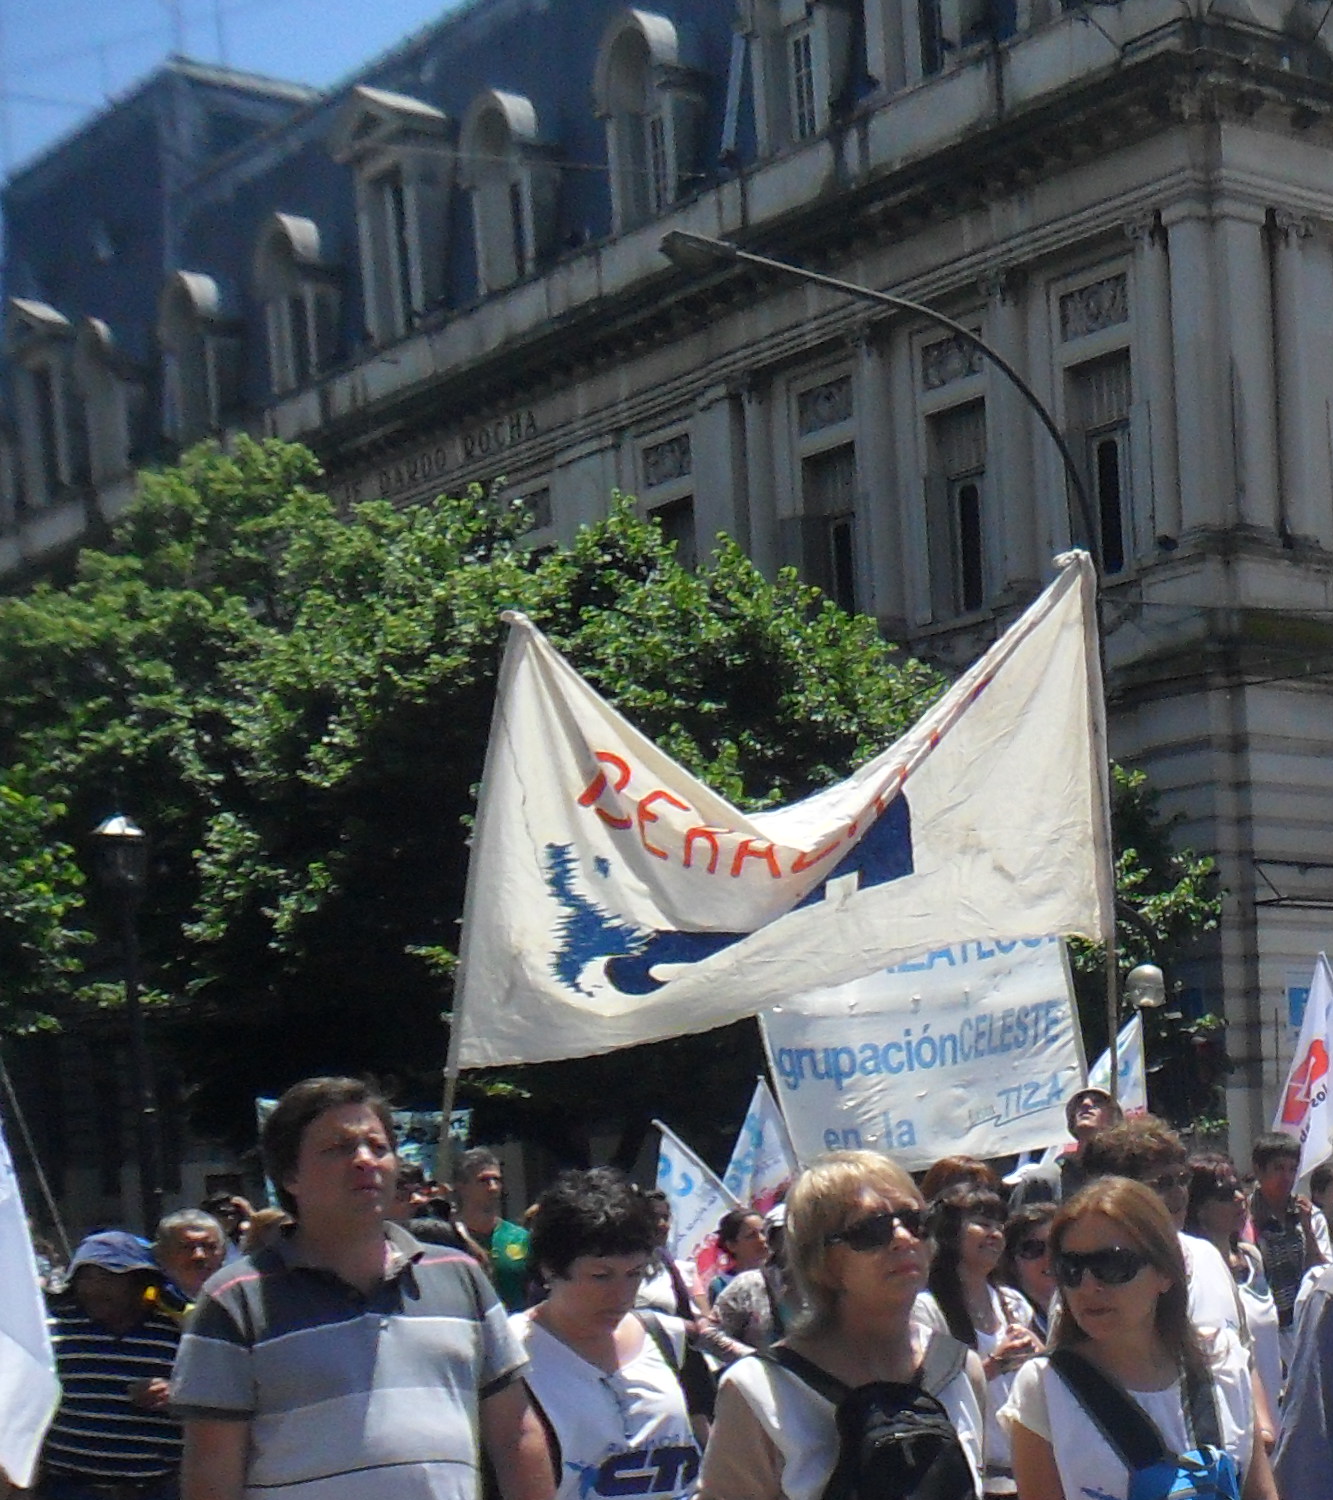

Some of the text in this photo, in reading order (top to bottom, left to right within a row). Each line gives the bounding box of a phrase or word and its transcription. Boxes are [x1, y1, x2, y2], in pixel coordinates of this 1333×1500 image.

[778, 1000, 1064, 1091] grupación CELESTE
[823, 1111, 917, 1151] en la
